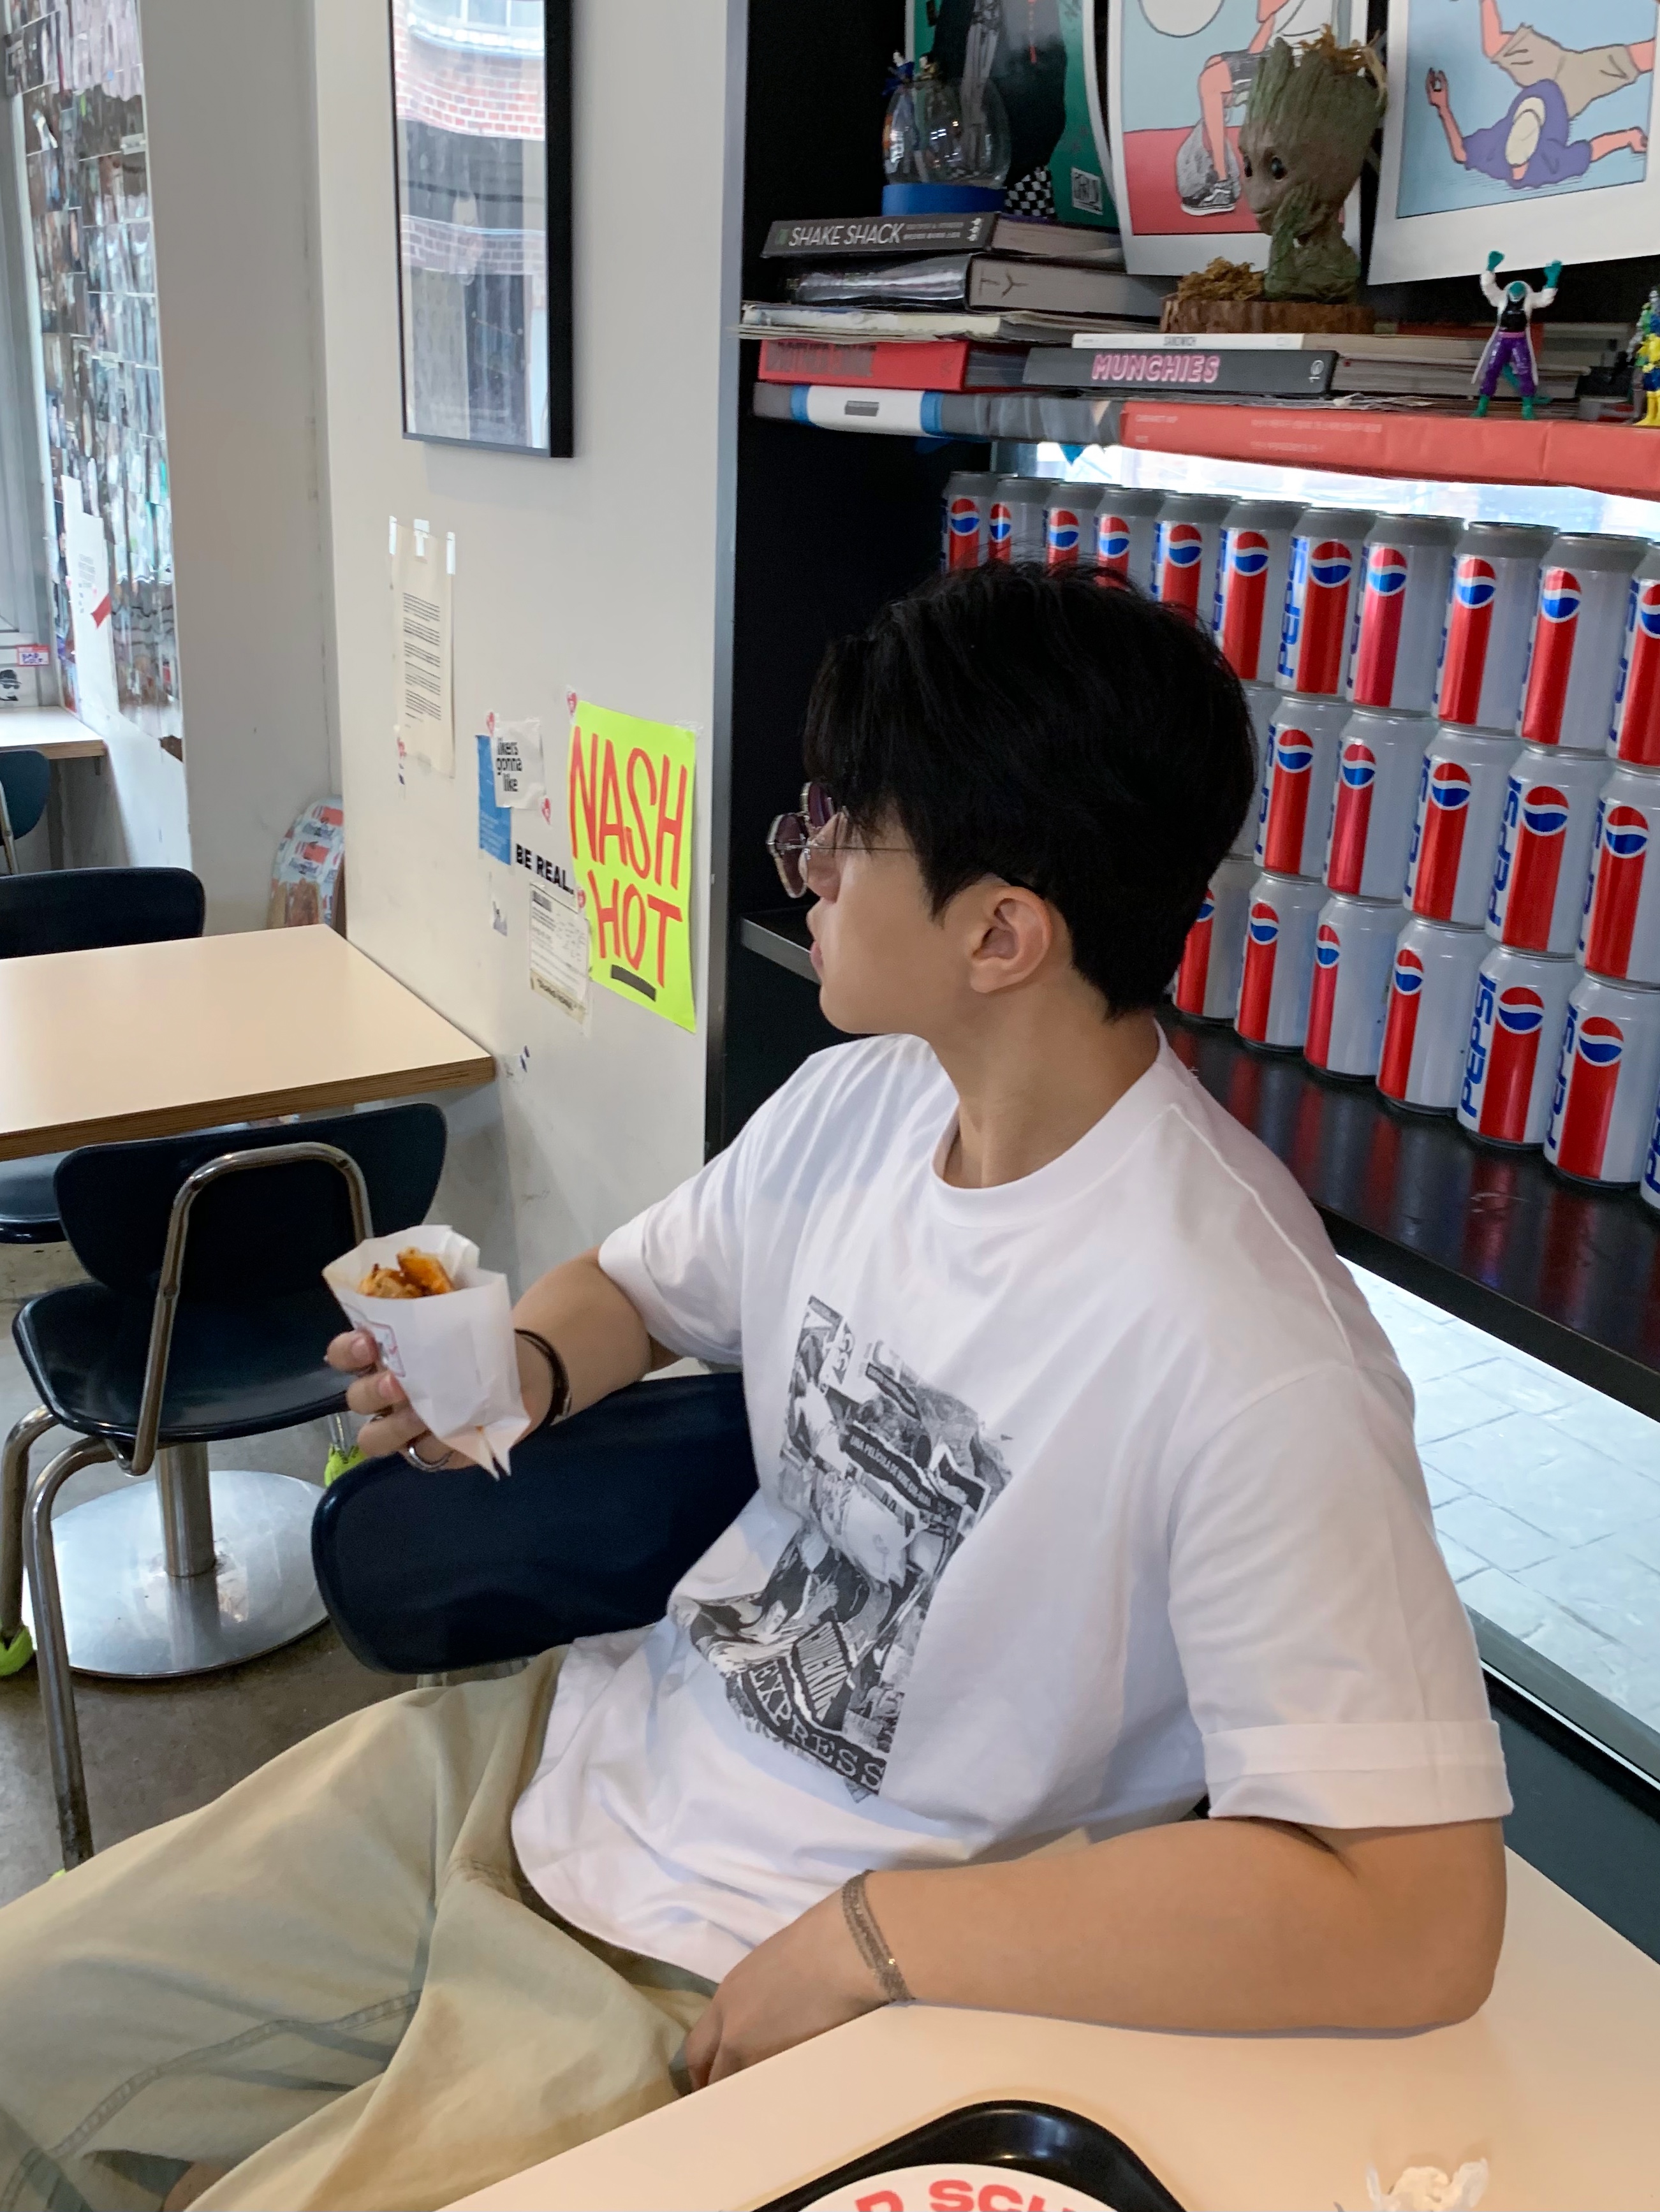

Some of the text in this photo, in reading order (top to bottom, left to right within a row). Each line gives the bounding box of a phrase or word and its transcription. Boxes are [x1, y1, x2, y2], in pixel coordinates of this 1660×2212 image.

[788, 223, 906, 247] SHAKE SHACK
[1091, 353, 1221, 384] MUNCHIES
[497, 737, 519, 756] likers
[496, 757, 523, 776] gonna
[503, 773, 518, 792] like
[568, 726, 689, 890] NASH
[516, 844, 533, 870] BE
[587, 870, 684, 988] HOT
[1460, 972, 1497, 1120] PEPSI
[749, 1660, 886, 1791] EXPRESS
